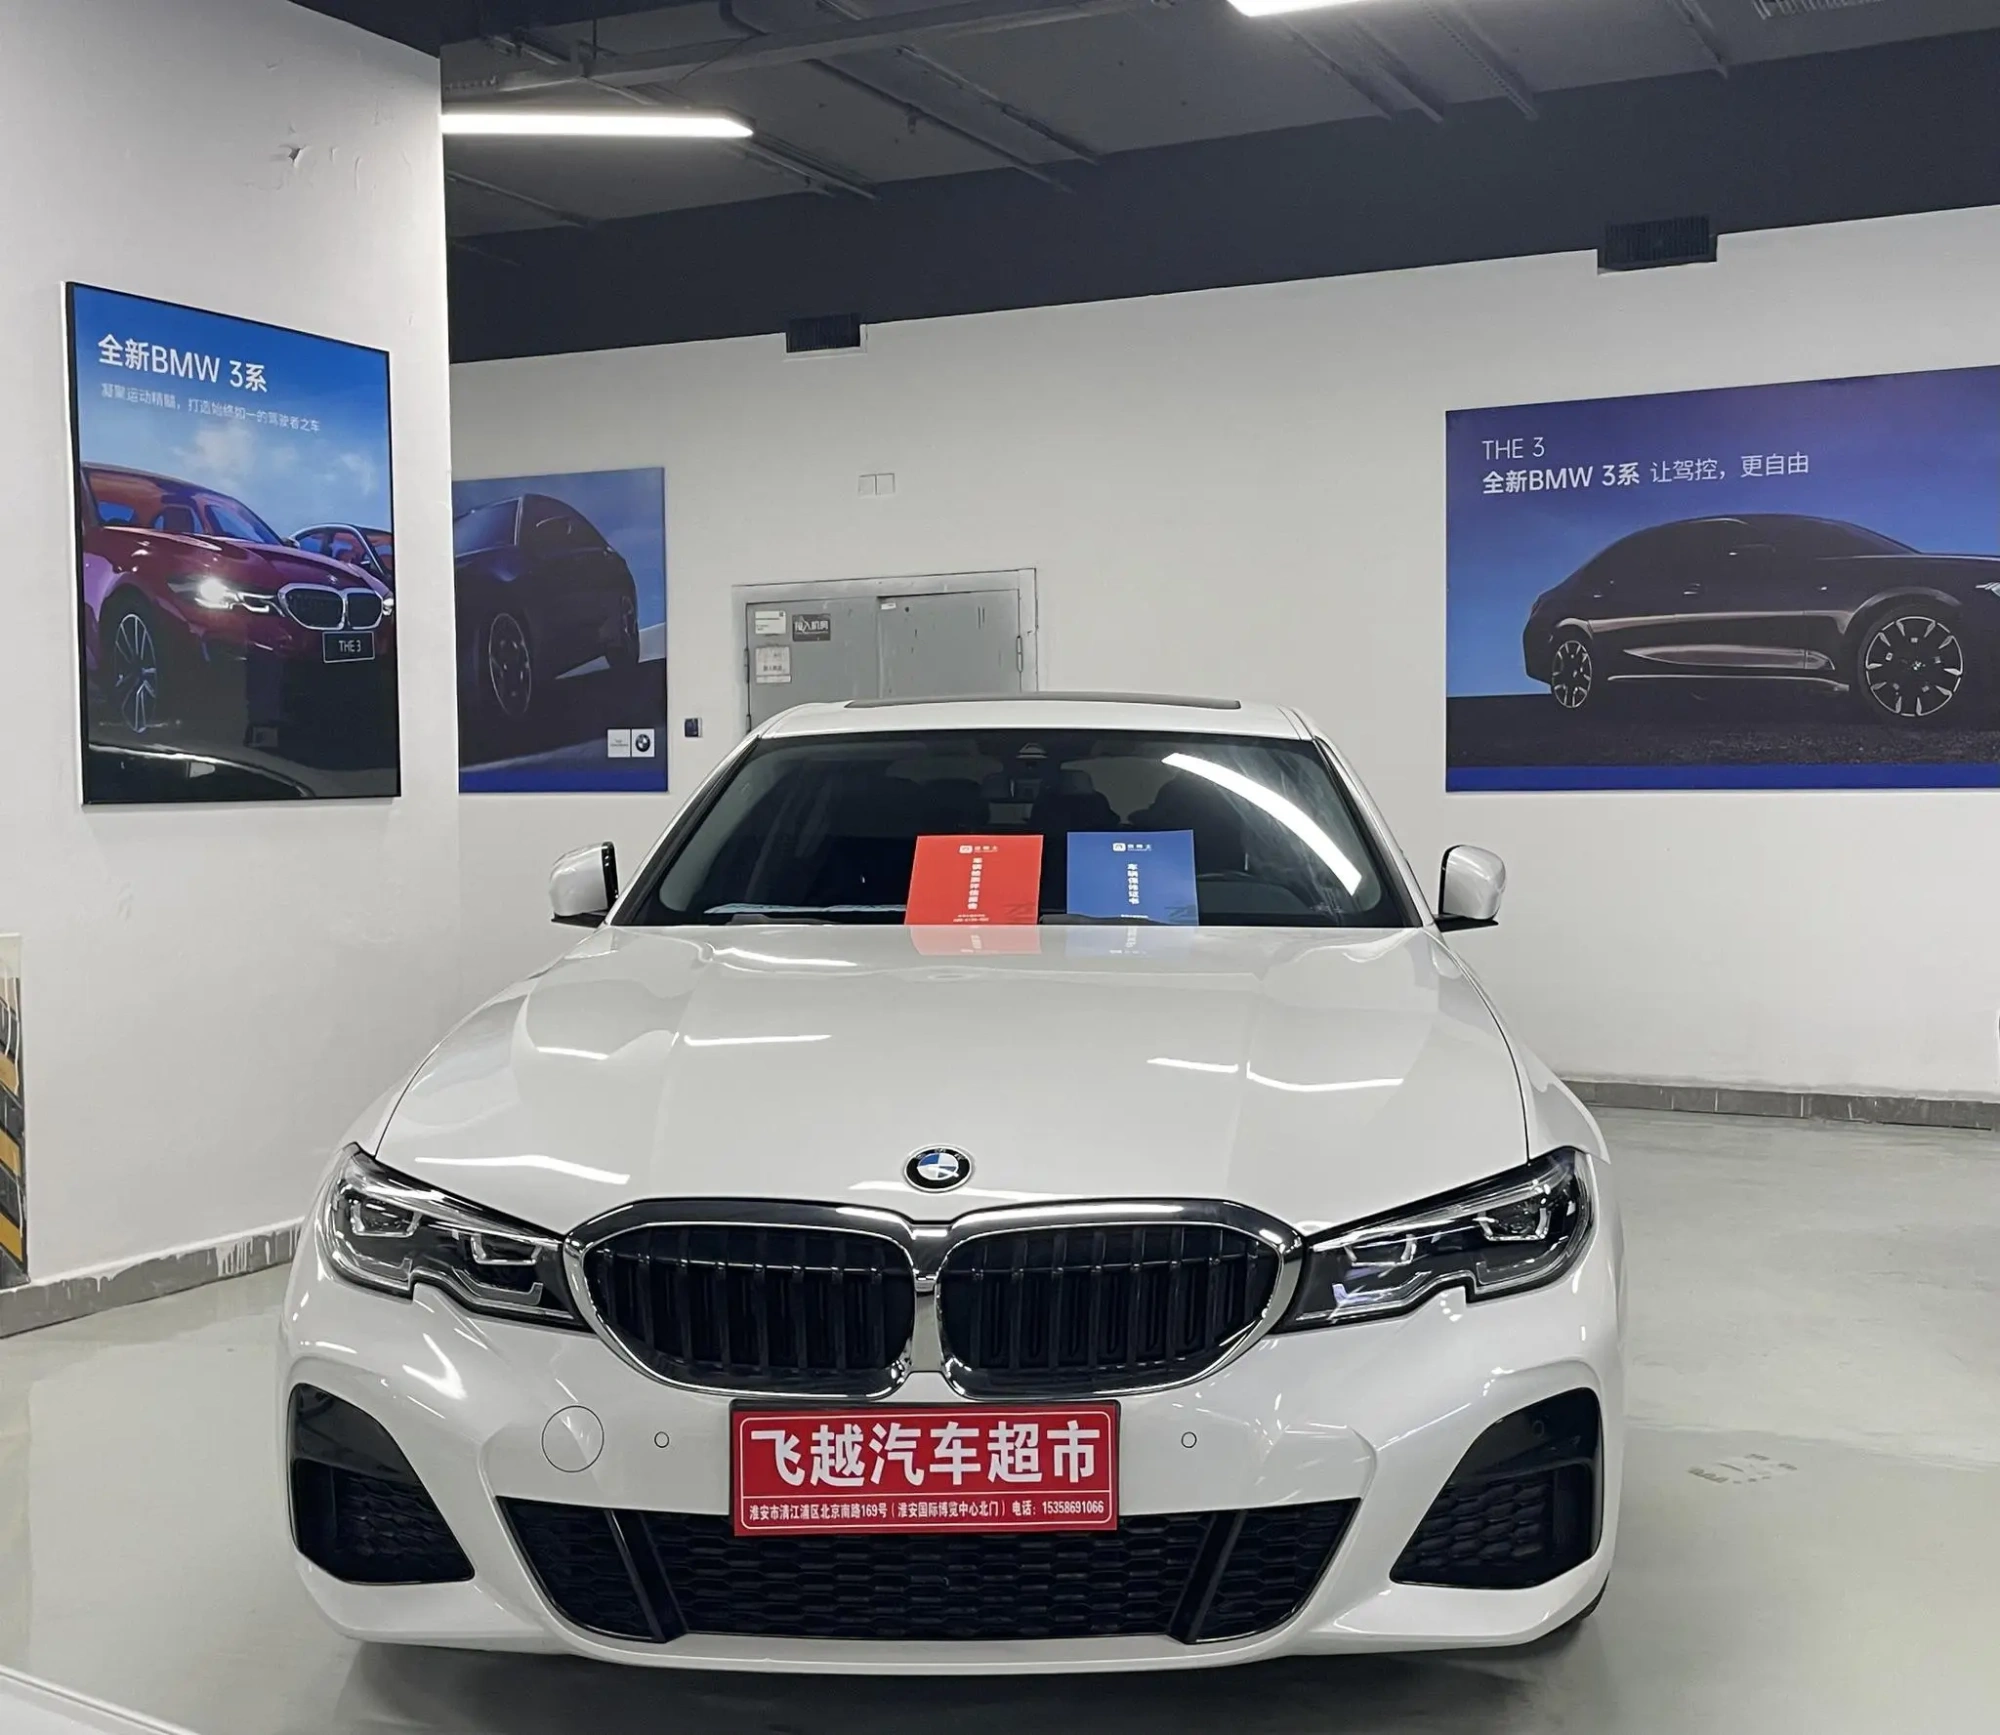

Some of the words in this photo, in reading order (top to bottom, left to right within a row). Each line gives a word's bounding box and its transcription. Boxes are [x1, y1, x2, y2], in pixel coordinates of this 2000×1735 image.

[98, 333, 220, 383] 全新BMW
[228, 359, 268, 393] 3系
[1482, 438, 1524, 461] THE
[1532, 437, 1546, 459] 3
[1482, 466, 1593, 496] 全新BMW
[1602, 462, 1641, 487] 3系
[1650, 451, 1810, 484] 让驾控，更自由
[338, 640, 355, 653] THE
[355, 639, 361, 653] 3
[750, 1420, 1100, 1487] 飞越汽车超市
